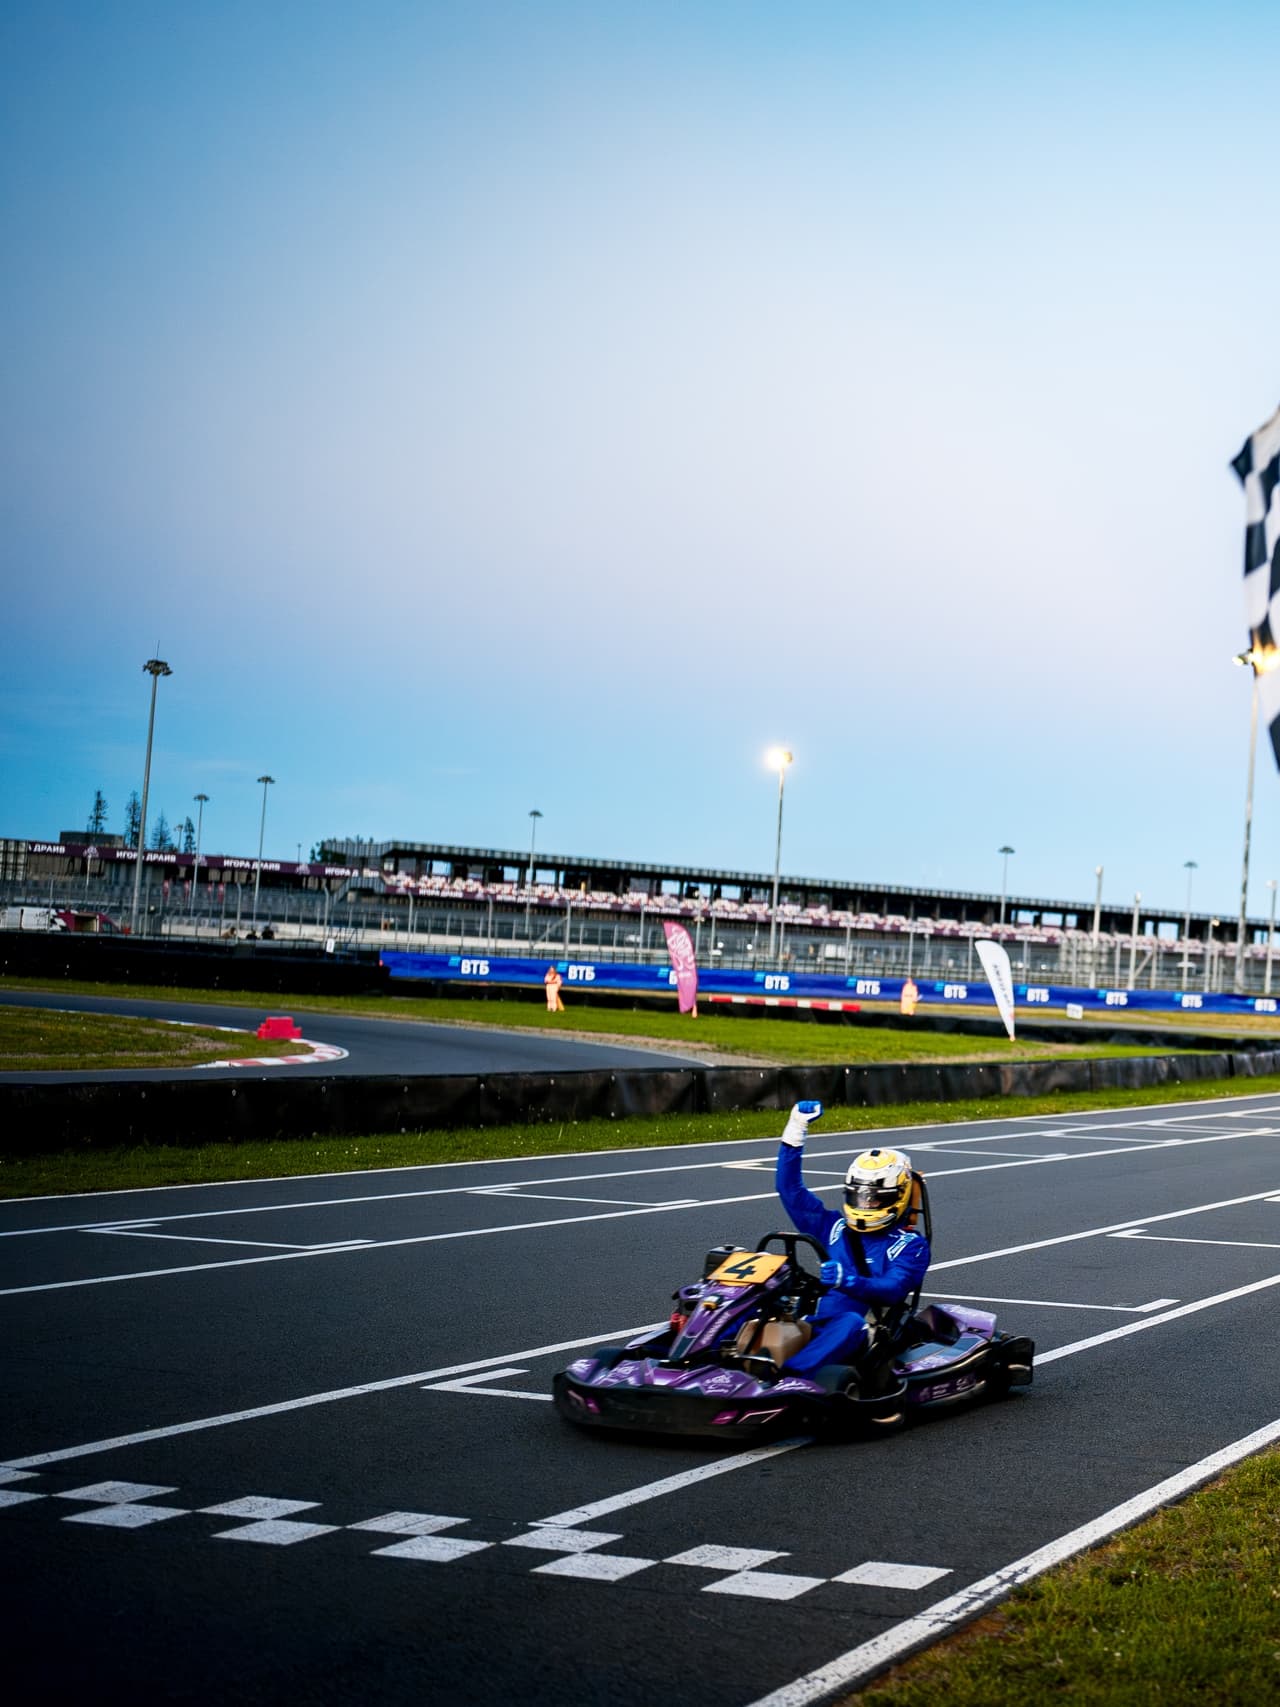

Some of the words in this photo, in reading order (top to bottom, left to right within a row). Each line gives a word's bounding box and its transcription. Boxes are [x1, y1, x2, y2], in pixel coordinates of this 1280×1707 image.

[461, 959, 490, 975] ВТБ
[568, 965, 596, 981] ВТБ
[764, 975, 790, 990] ВТБ
[856, 980, 880, 995] ВТБ
[944, 984, 967, 999] ВТБ
[723, 1255, 763, 1279] 4
